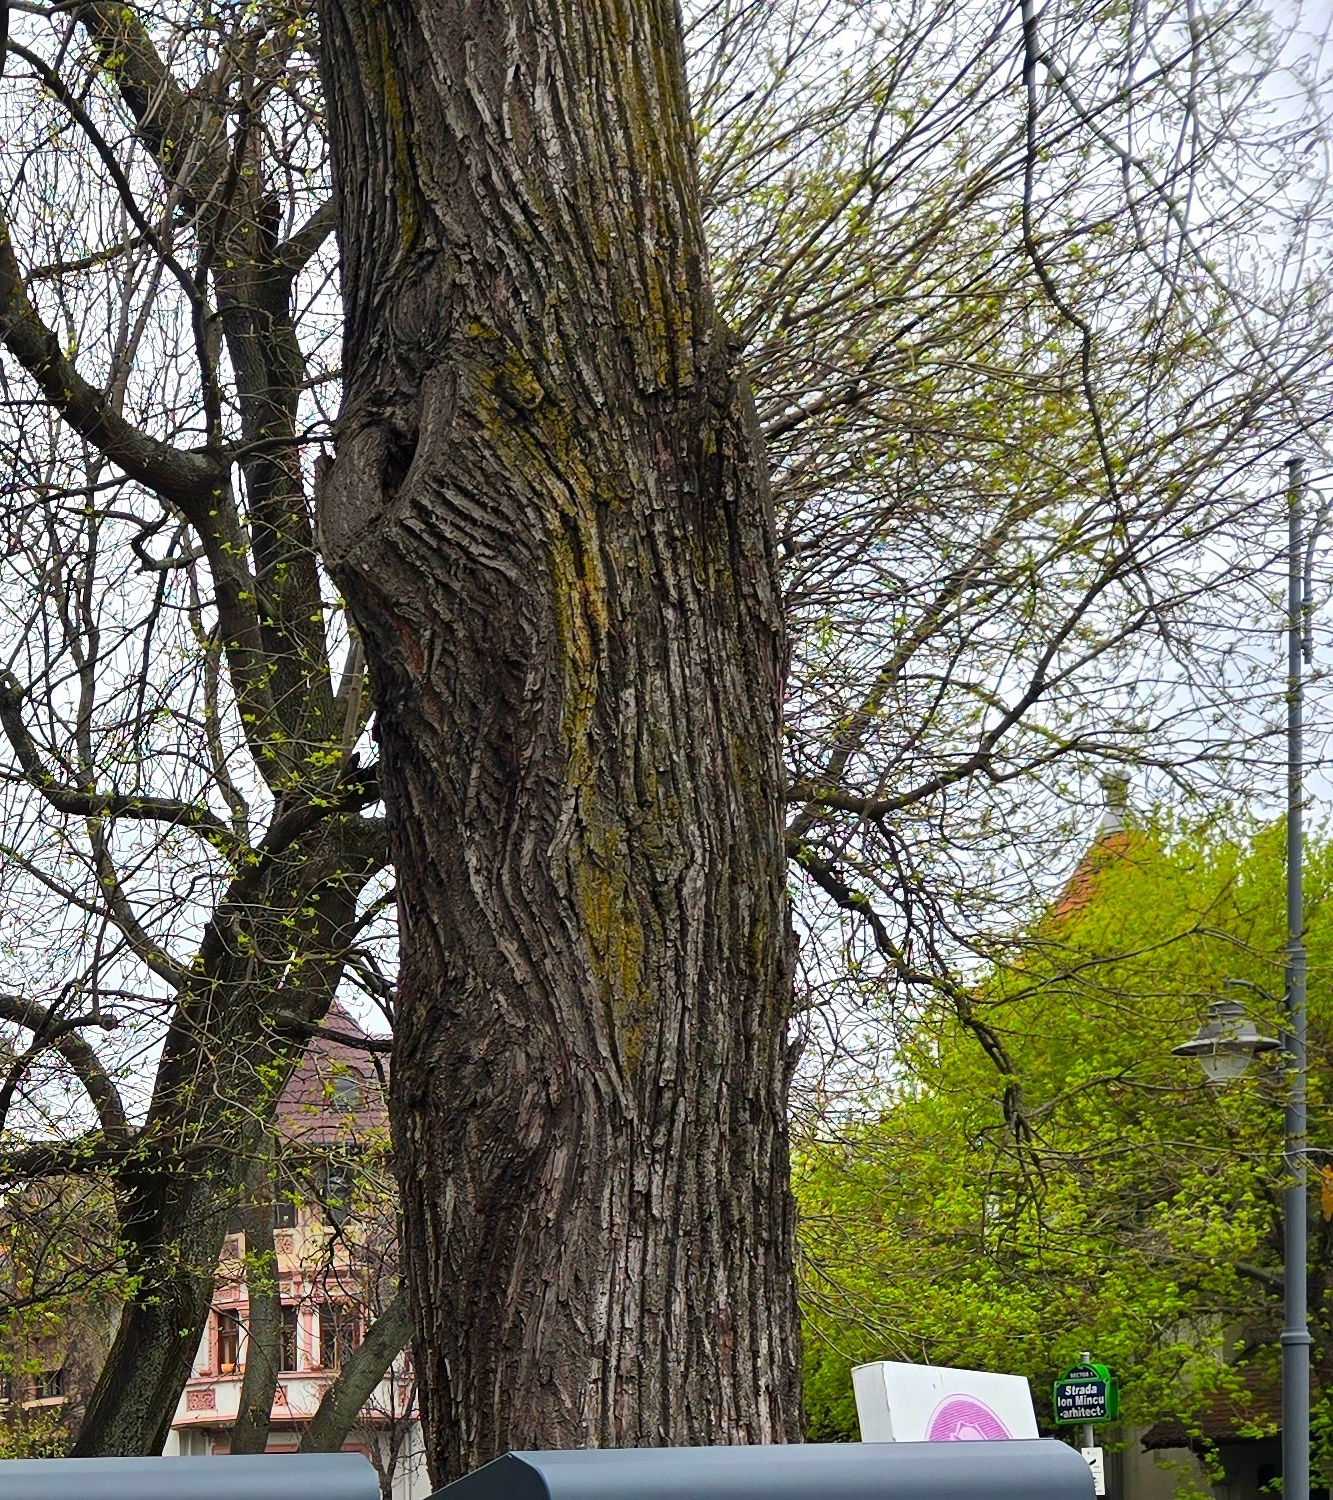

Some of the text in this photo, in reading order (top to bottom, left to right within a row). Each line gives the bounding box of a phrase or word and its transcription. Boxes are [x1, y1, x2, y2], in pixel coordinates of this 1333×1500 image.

[1065, 1384, 1097, 1395] Strada
[1058, 1395, 1104, 1407] Ion Mincu
